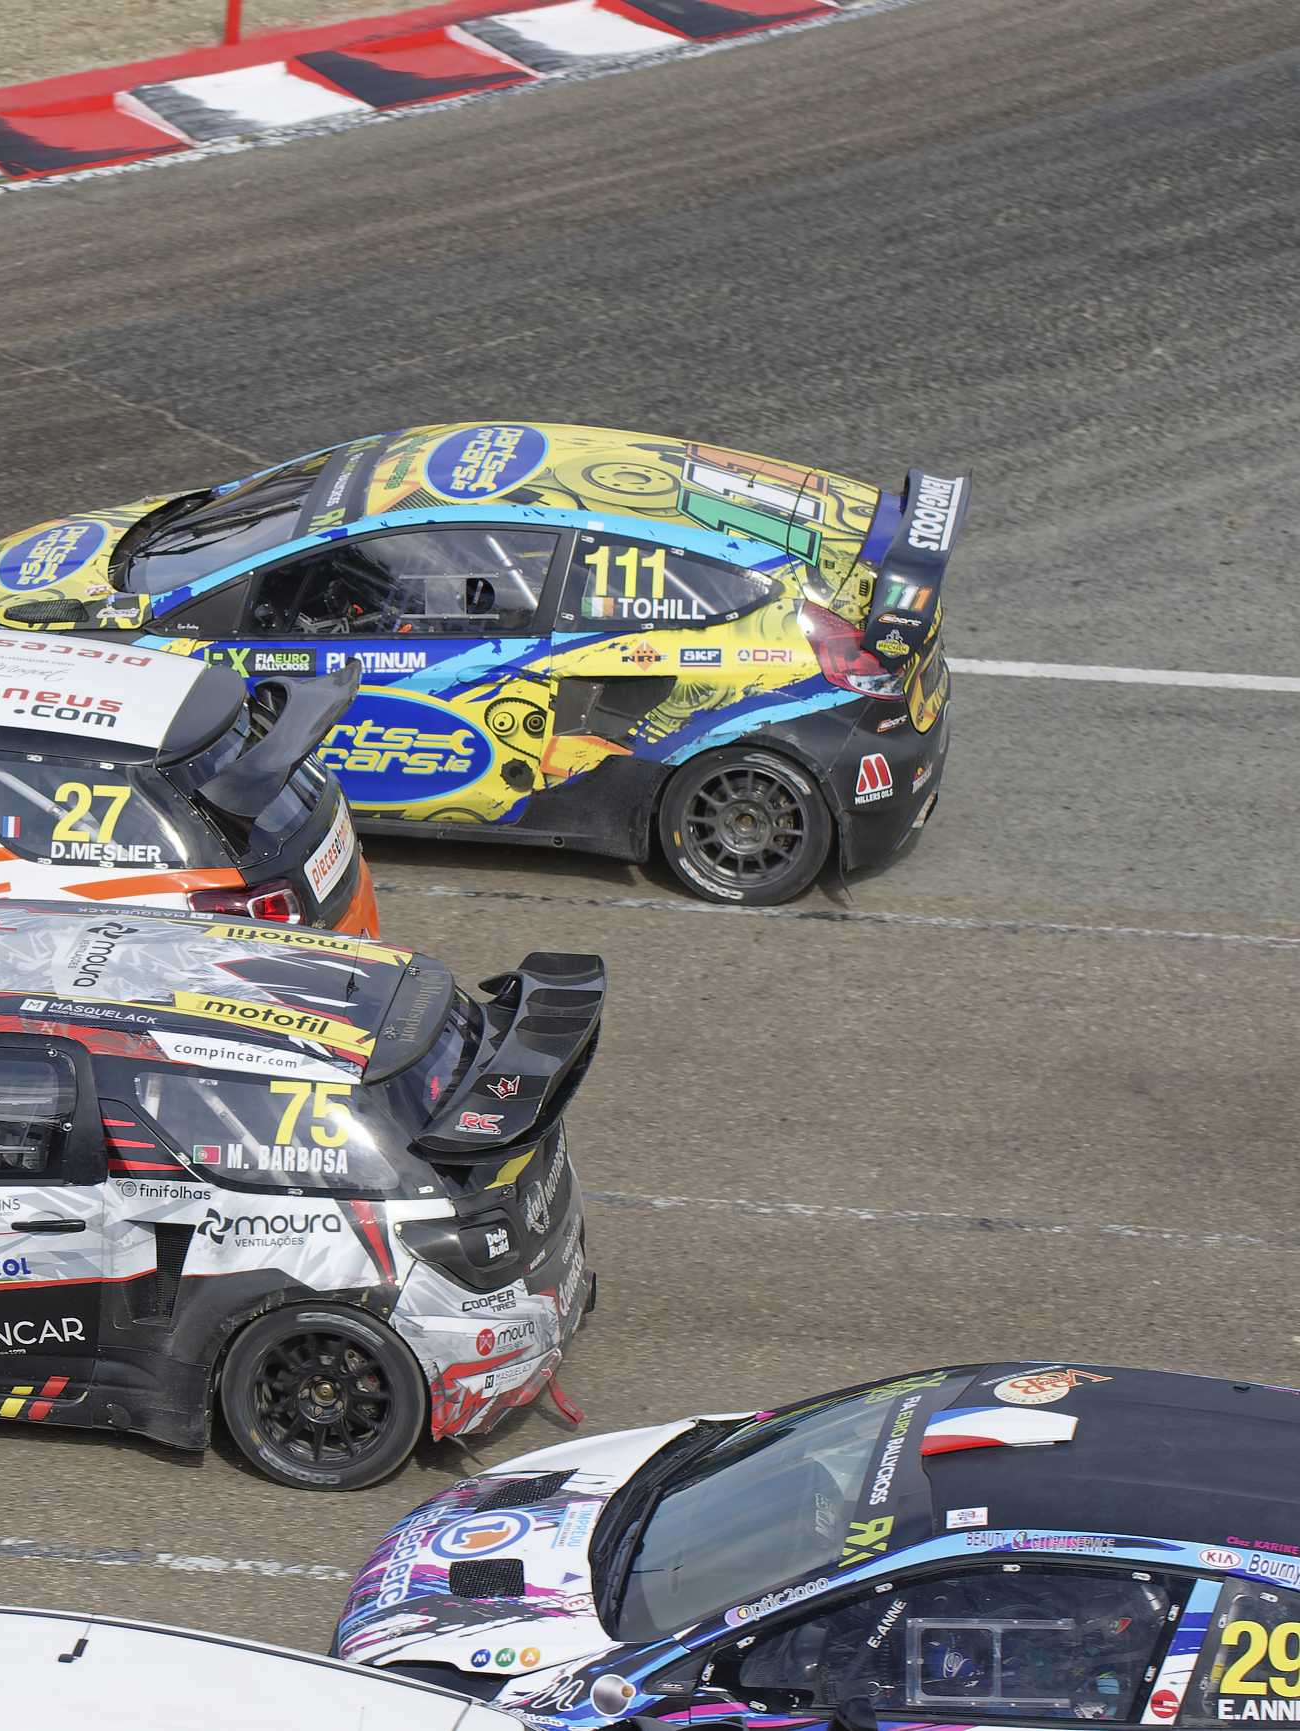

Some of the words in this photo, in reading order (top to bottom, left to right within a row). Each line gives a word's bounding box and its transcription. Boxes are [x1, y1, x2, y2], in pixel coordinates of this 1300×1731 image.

[584, 545, 666, 599] 111
[617, 597, 706, 620] TOHILL
[255, 662, 310, 671] RALLYCROSS
[683, 651, 720, 662] SKF
[13, 705, 118, 728] .com
[52, 782, 132, 844] 27
[51, 841, 162, 863] D.MESLIER
[227, 927, 350, 952] motofil
[73, 941, 116, 988] moura
[49, 1001, 159, 1025] MASQUELACK
[204, 1000, 331, 1034] motofil
[174, 1043, 298, 1069] compincar.com
[270, 1080, 351, 1148] 75
[227, 1143, 250, 1169] M.
[257, 1145, 349, 1174] BARBOSA
[139, 1183, 212, 1200] finifolhas
[235, 1214, 342, 1235] moura
[235, 1236, 306, 1248] VENTILAÇÕES
[462, 1289, 516, 1313] COOPER
[869, 1438, 903, 1506] RALLYCROSS
[1206, 1553, 1234, 1566] KIA
